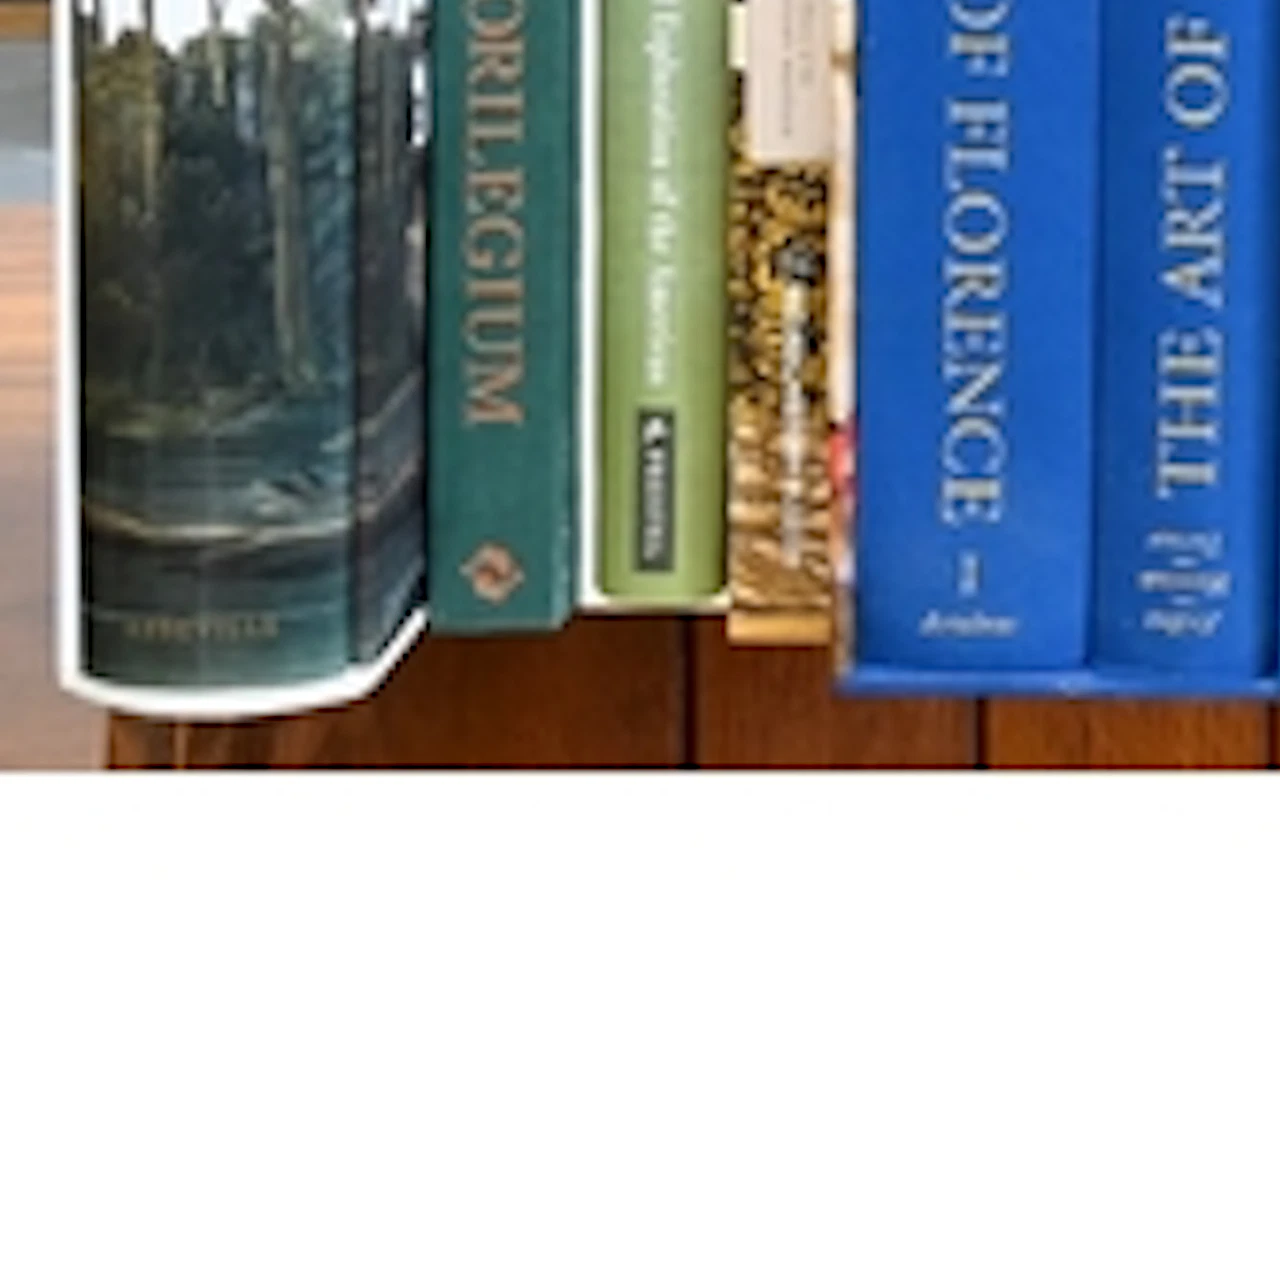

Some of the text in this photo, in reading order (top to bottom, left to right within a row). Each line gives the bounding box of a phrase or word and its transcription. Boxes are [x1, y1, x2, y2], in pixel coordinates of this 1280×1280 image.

[1164, 14, 1230, 130] OF
[941, 97, 1010, 525] FLORENCE
[1162, 146, 1227, 310] ART
[1155, 328, 1225, 500] THE
